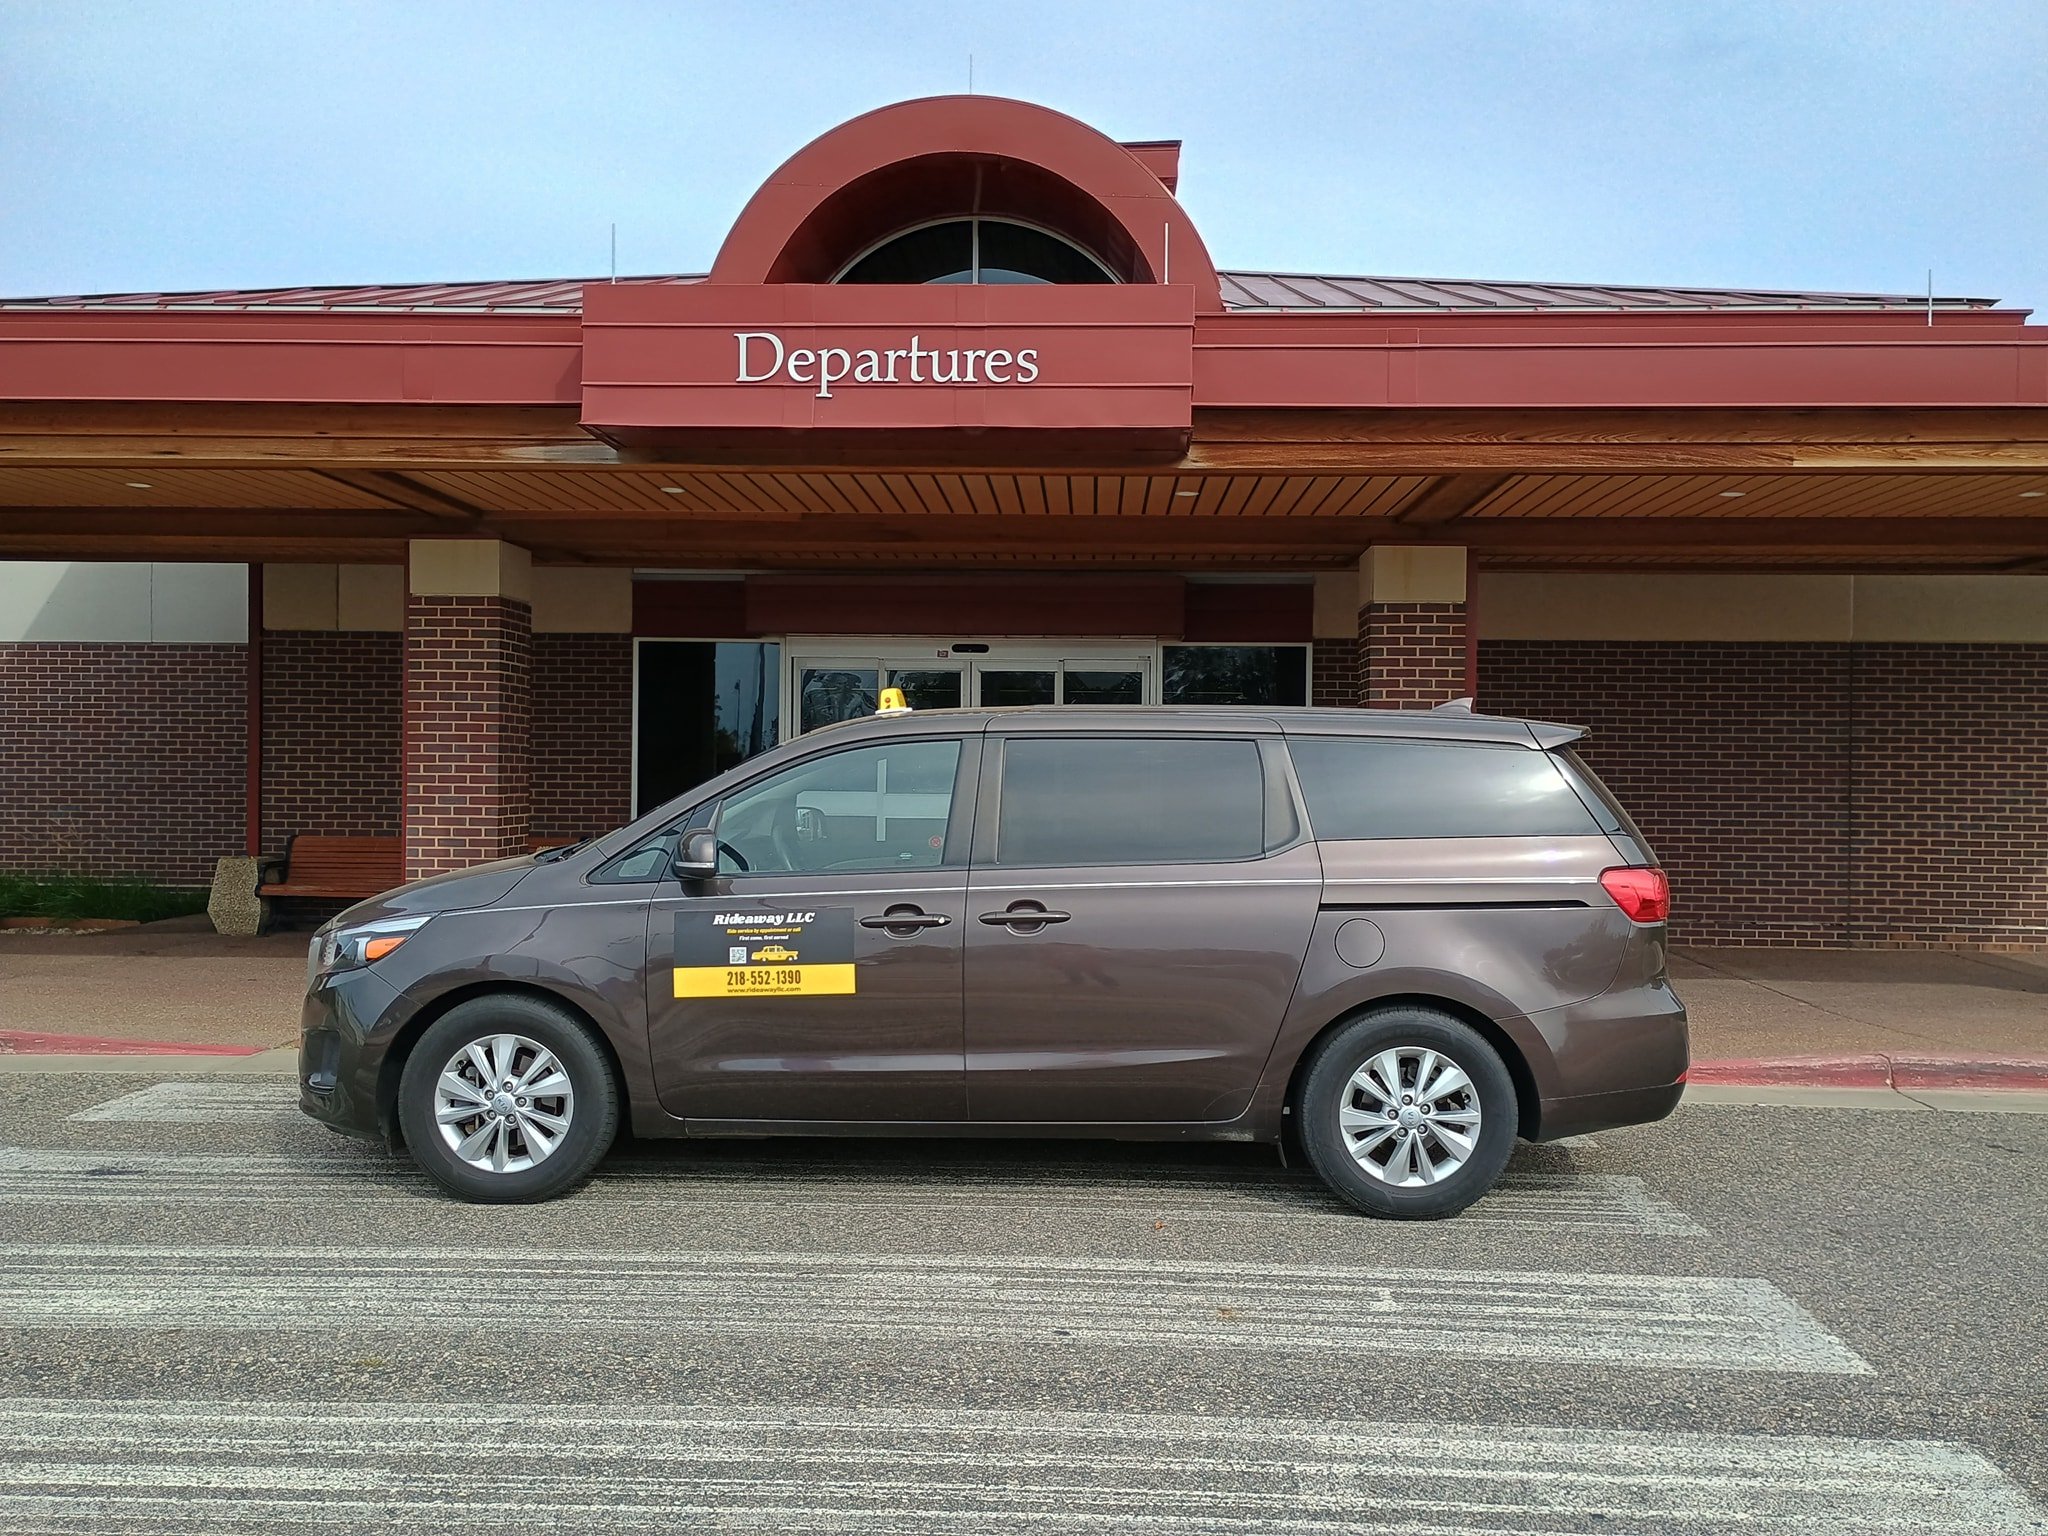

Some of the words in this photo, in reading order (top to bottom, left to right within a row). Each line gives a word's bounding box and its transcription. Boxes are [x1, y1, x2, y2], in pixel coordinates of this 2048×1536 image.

[733, 332, 1039, 398] Departures
[712, 913, 784, 926] Rideaway
[786, 912, 815, 923] LLC
[727, 970, 801, 986] 218-552-1390
[497, 1097, 509, 1111] KIA
